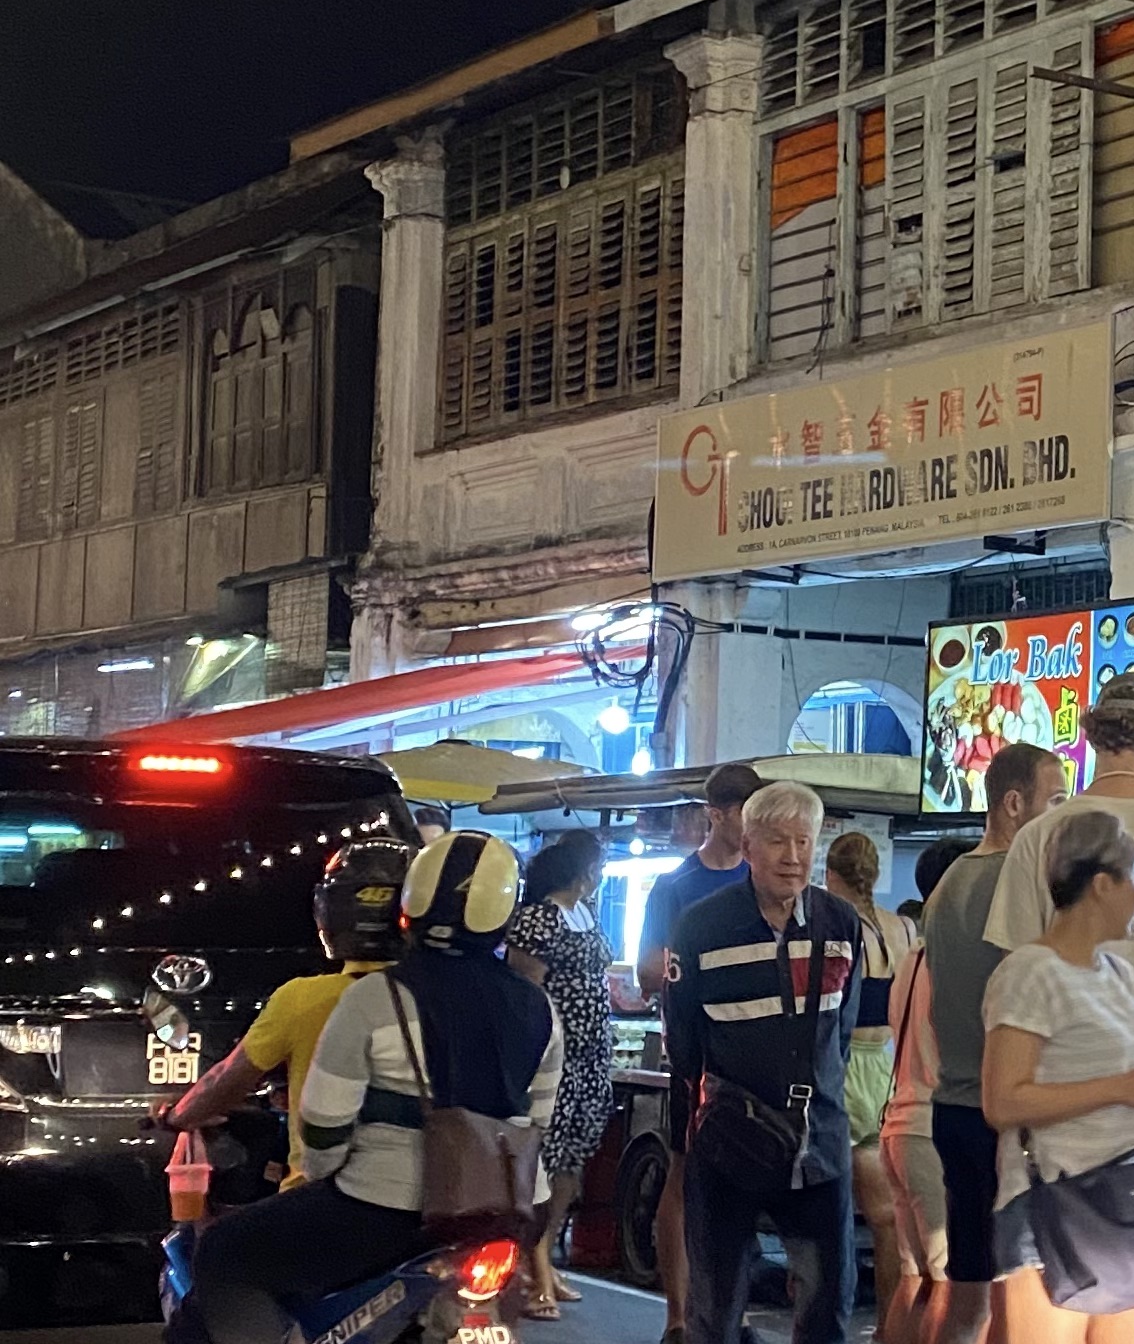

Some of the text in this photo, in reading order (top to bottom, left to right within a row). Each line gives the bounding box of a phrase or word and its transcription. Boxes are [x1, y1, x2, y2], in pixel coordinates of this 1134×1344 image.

[801, 477, 833, 523] TEE
[965, 445, 1015, 497] SDN.
[1023, 435, 1076, 487] BHD.
[971, 621, 1082, 685] Lor Bak
[149, 1053, 199, 1085] 8181
